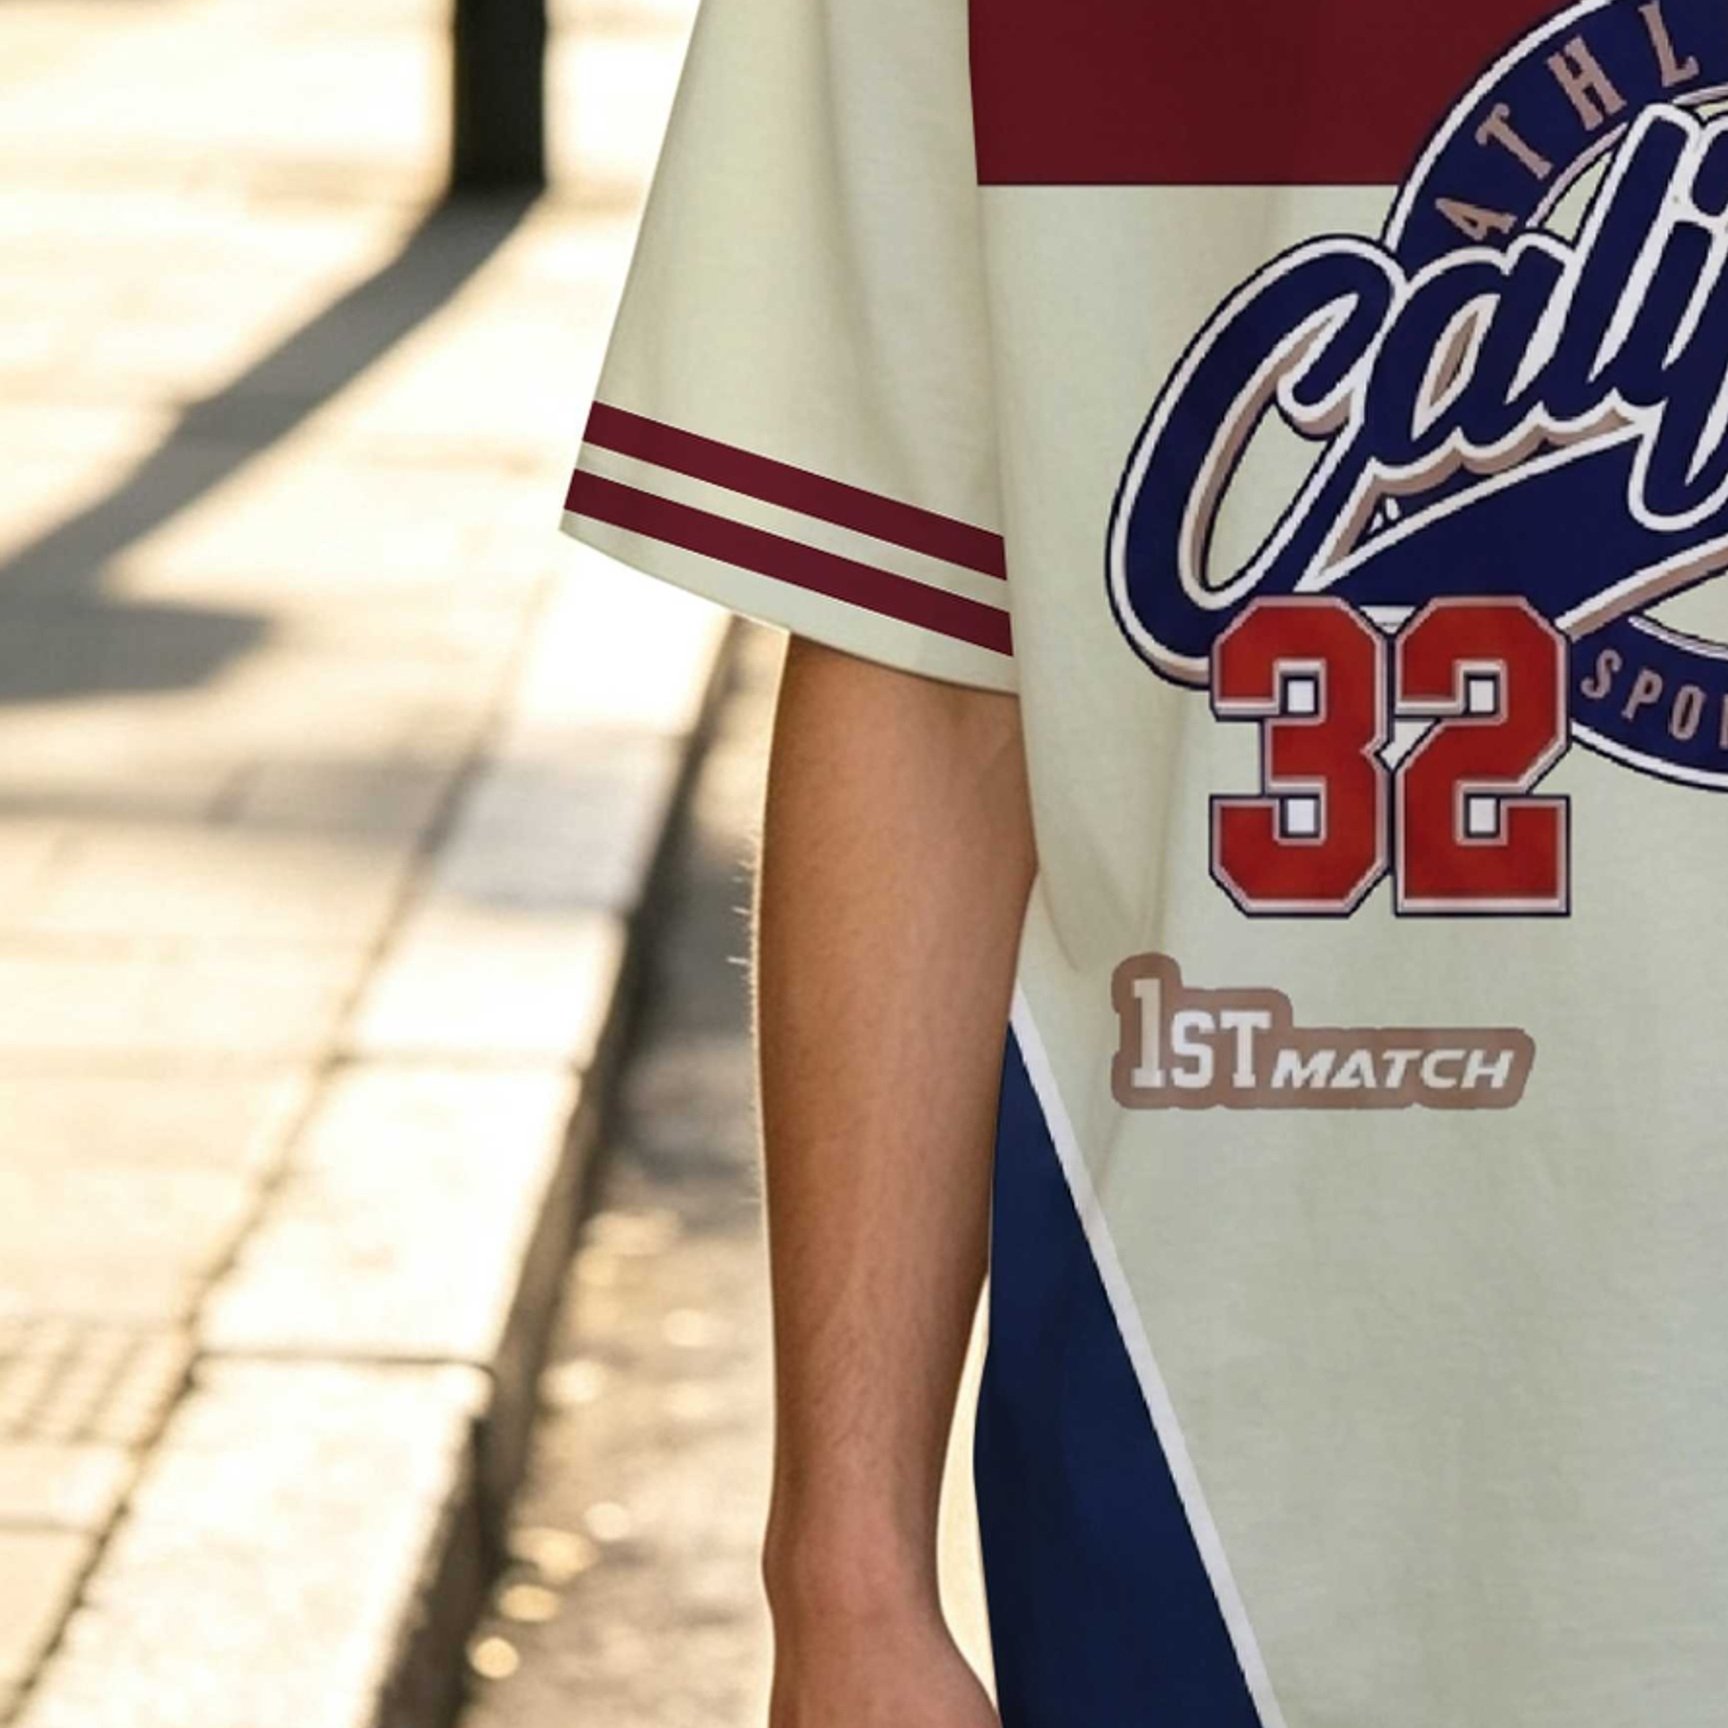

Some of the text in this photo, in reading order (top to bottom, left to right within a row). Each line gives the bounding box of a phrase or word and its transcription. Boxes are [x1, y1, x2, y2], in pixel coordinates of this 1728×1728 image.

[1209, 595, 1571, 917] 32
[1131, 977, 1515, 1089] 1ST MATCH
